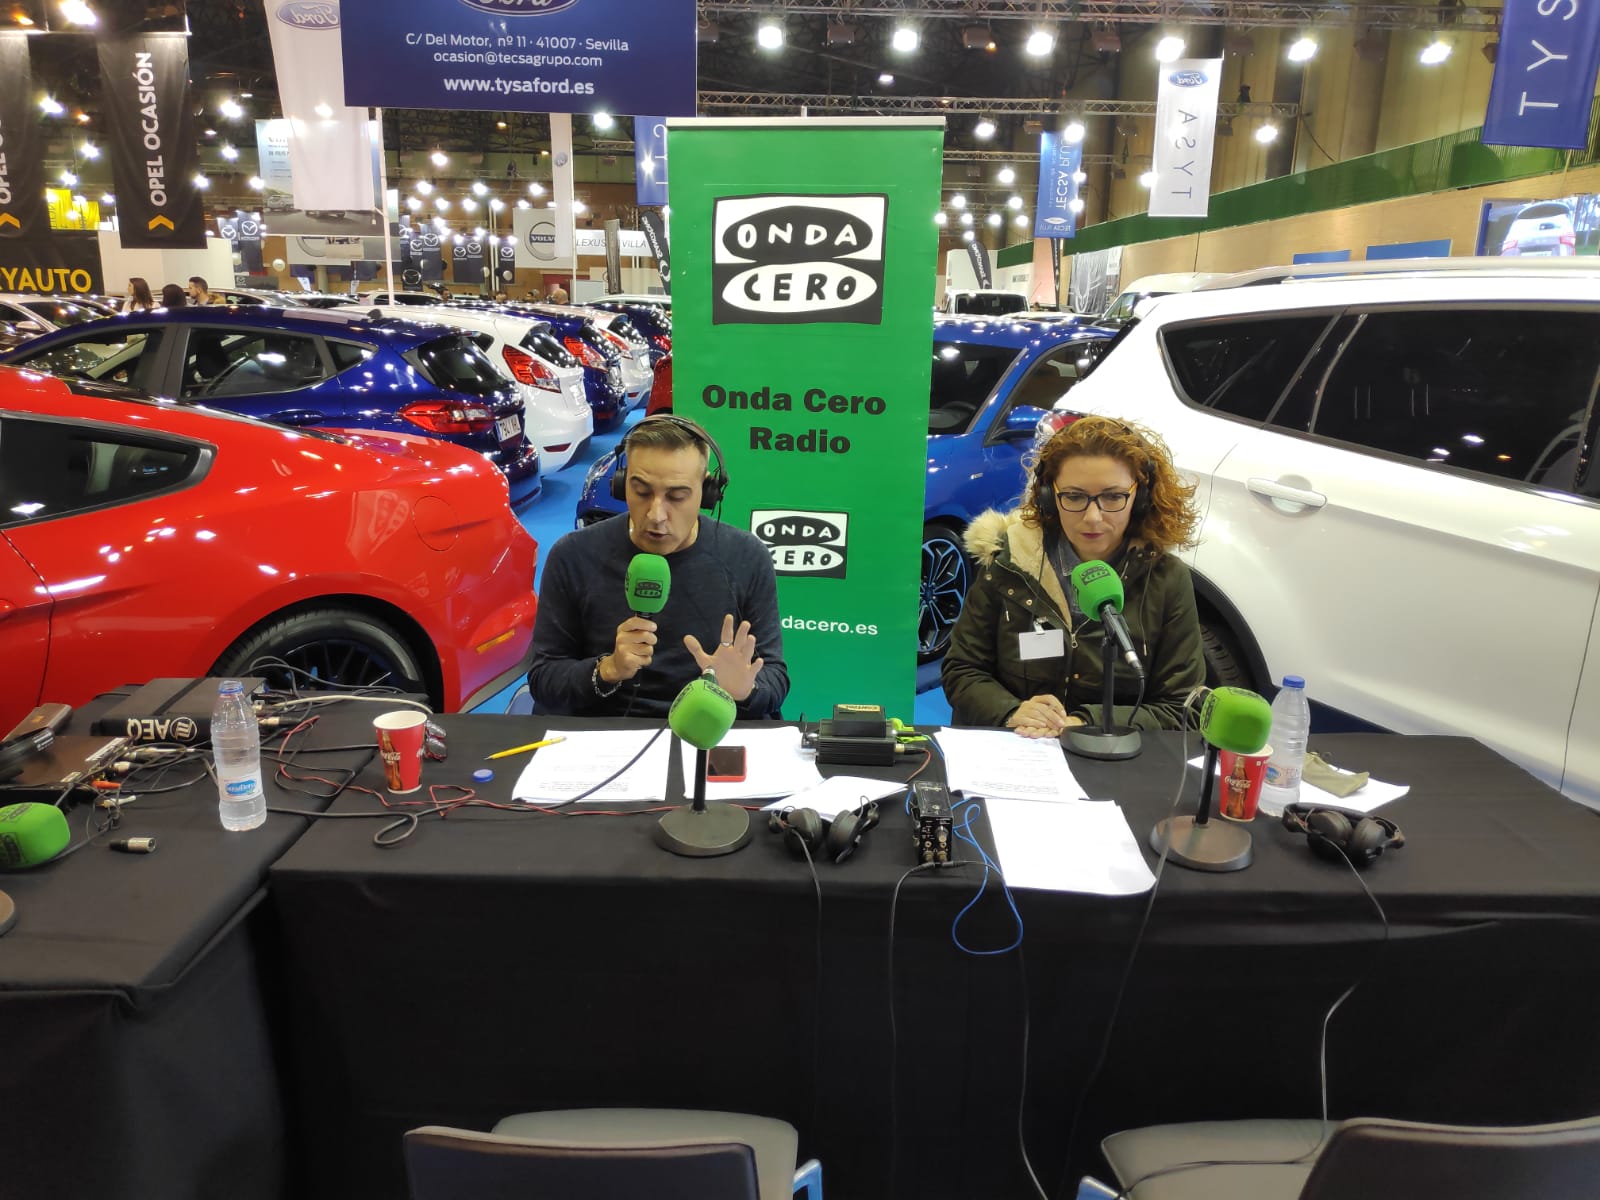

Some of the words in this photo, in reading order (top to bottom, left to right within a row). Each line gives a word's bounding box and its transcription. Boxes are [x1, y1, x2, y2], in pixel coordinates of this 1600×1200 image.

[425, 33, 447, 46] Del
[450, 34, 493, 48] Motor,
[517, 36, 526, 48] 11
[535, 36, 577, 49] 41007
[585, 38, 629, 51] Sevilla
[433, 51, 603, 67] ocasion@tecsagrupo.com
[443, 77, 595, 95] www.tysaford.es
[132, 52, 161, 151] OCASIÓN
[146, 155, 167, 207] OPEL
[576, 238, 607, 247] LEXUS
[621, 239, 647, 248] VILLA
[737, 222, 858, 249] ONDA
[0, 267, 92, 293] YAUTO
[743, 272, 857, 301] CERO
[702, 384, 792, 411] Onda
[803, 388, 886, 415] Cero
[750, 426, 851, 454] Radio
[763, 523, 833, 538] ONDA
[781, 615, 878, 636] dacero.es
[127, 718, 171, 740] AEQ
